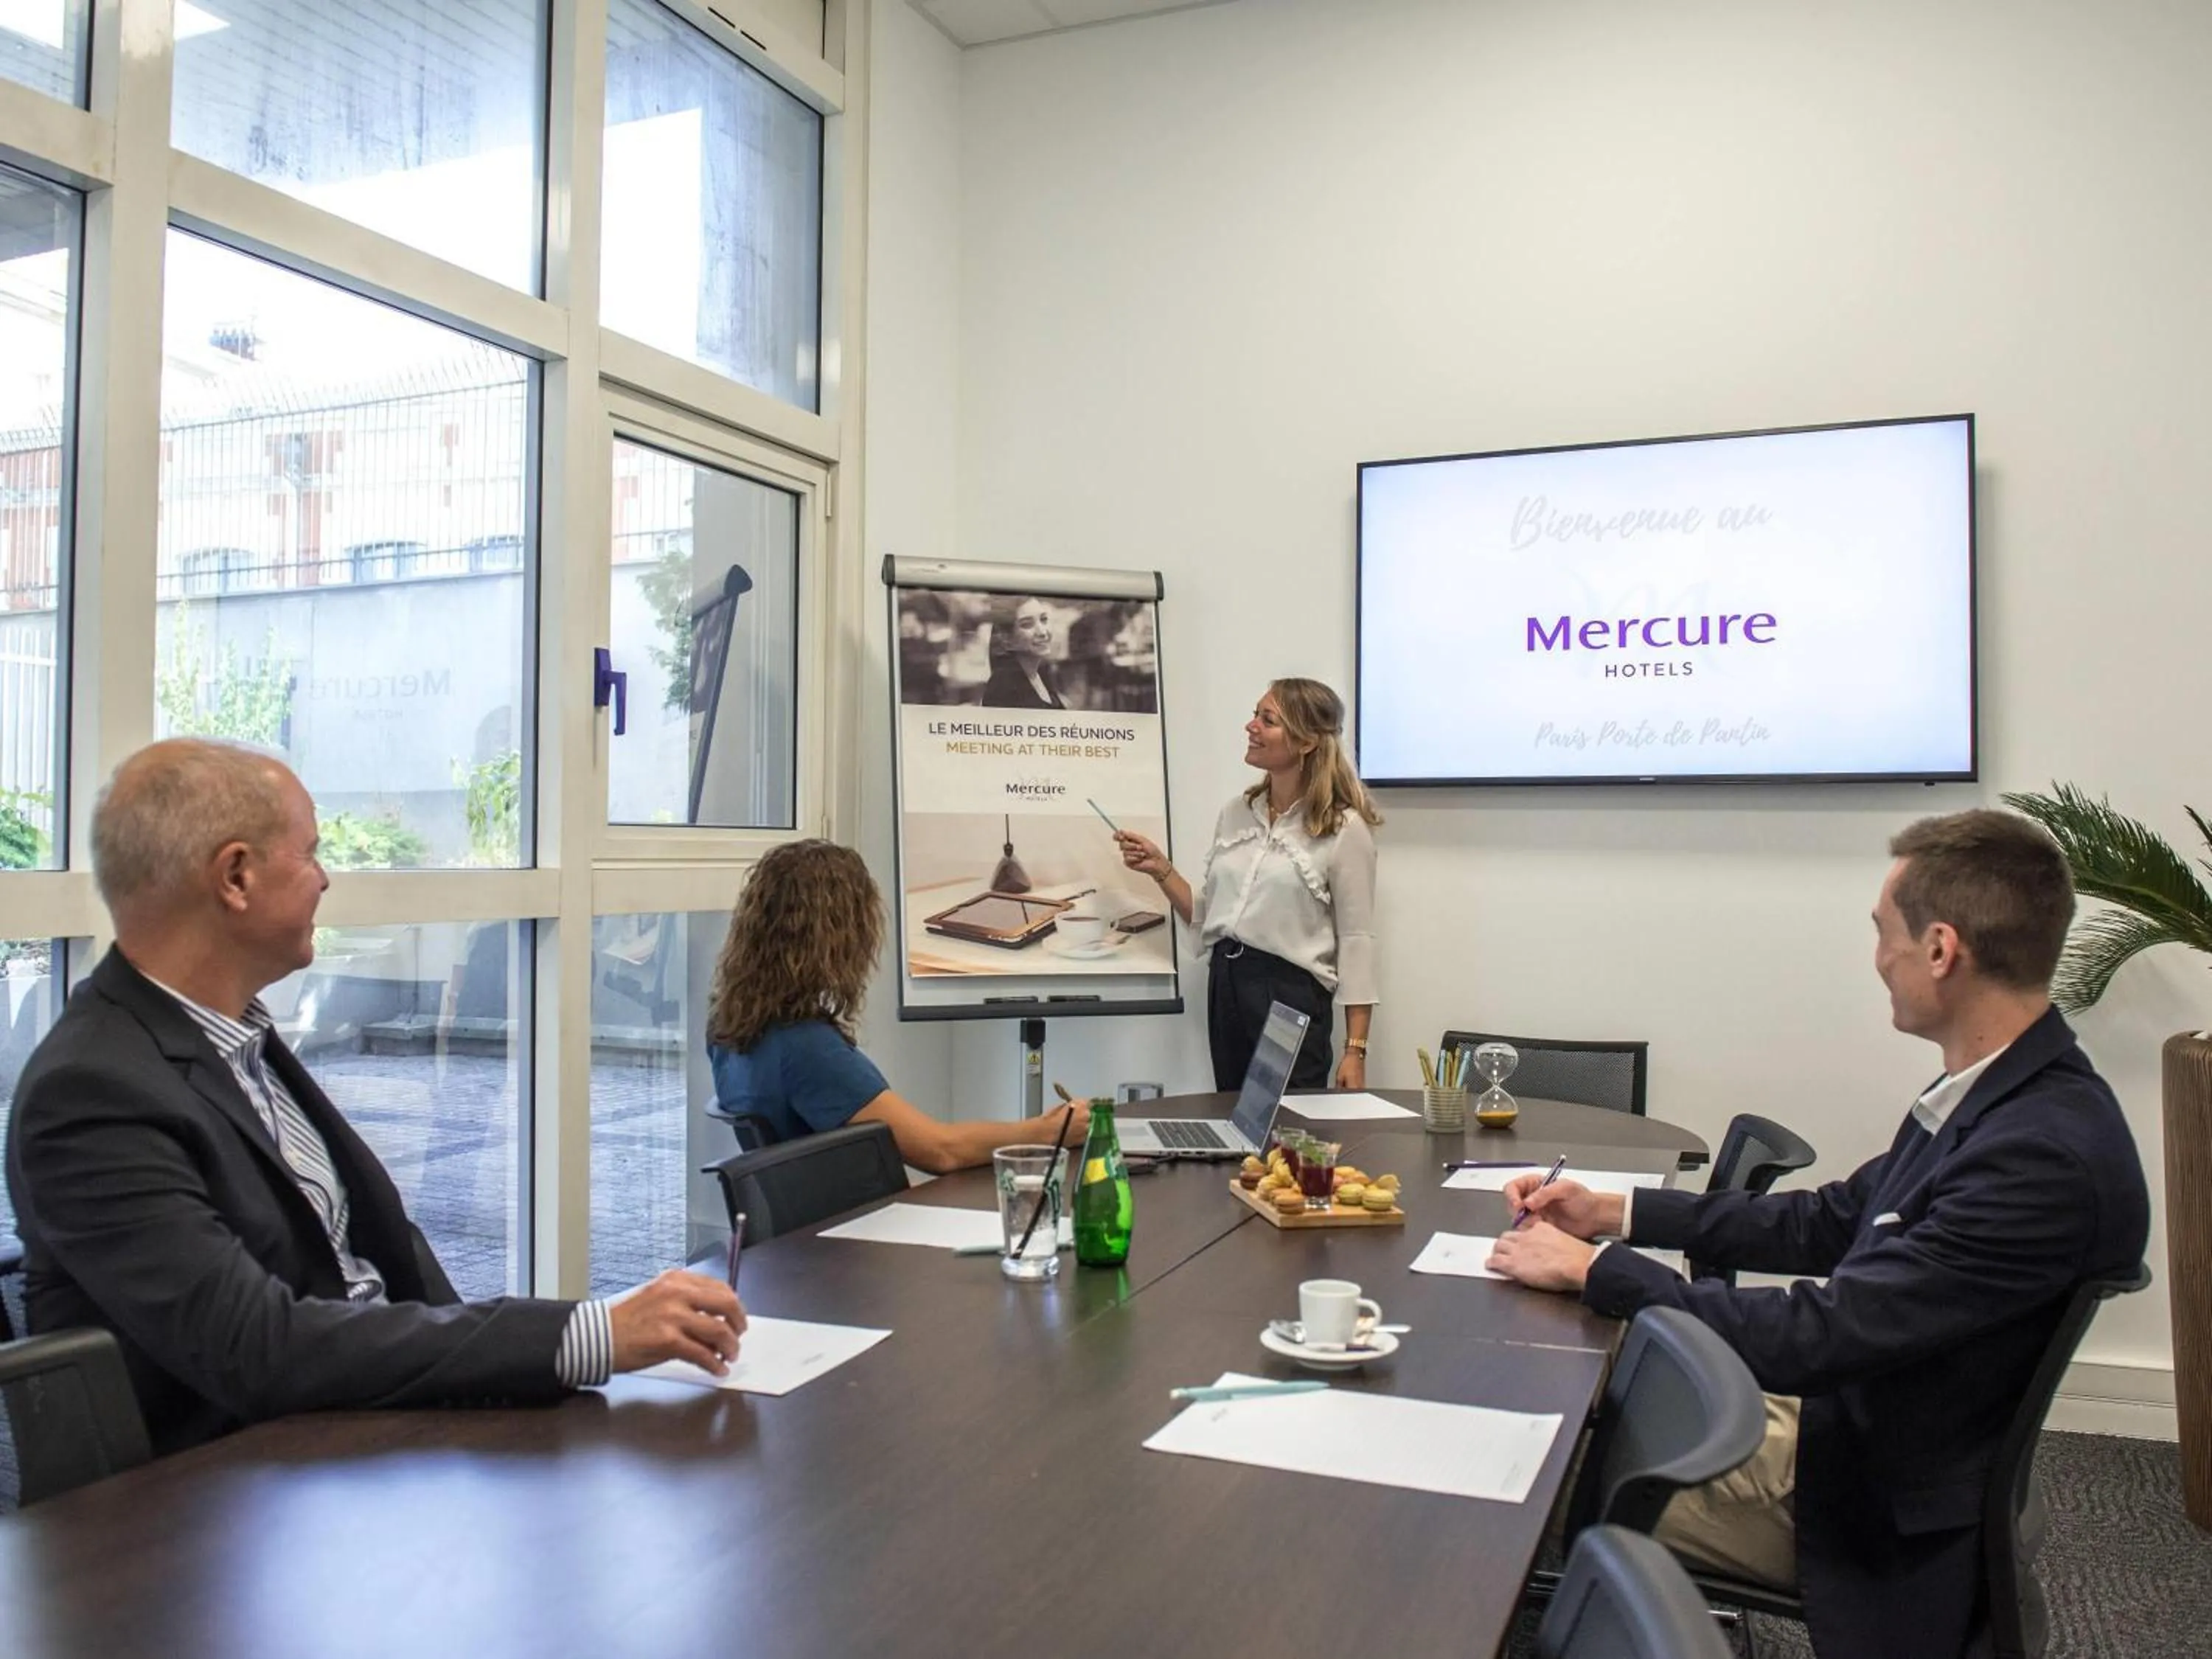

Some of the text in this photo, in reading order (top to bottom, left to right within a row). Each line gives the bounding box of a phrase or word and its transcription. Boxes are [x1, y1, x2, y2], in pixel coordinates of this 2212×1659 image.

[1509, 493, 1773, 552] Bienvenue au
[1526, 613, 1778, 652] Mercure
[1605, 661, 1694, 678] HOTELS
[928, 723, 1135, 740] LE MEILLEUR DES RÉUNIONS
[1534, 716, 1772, 751] Paris Porte de Pantin
[946, 742, 1120, 758] MEETING AT THEIR BEST
[1006, 783, 1066, 794] Mercure
